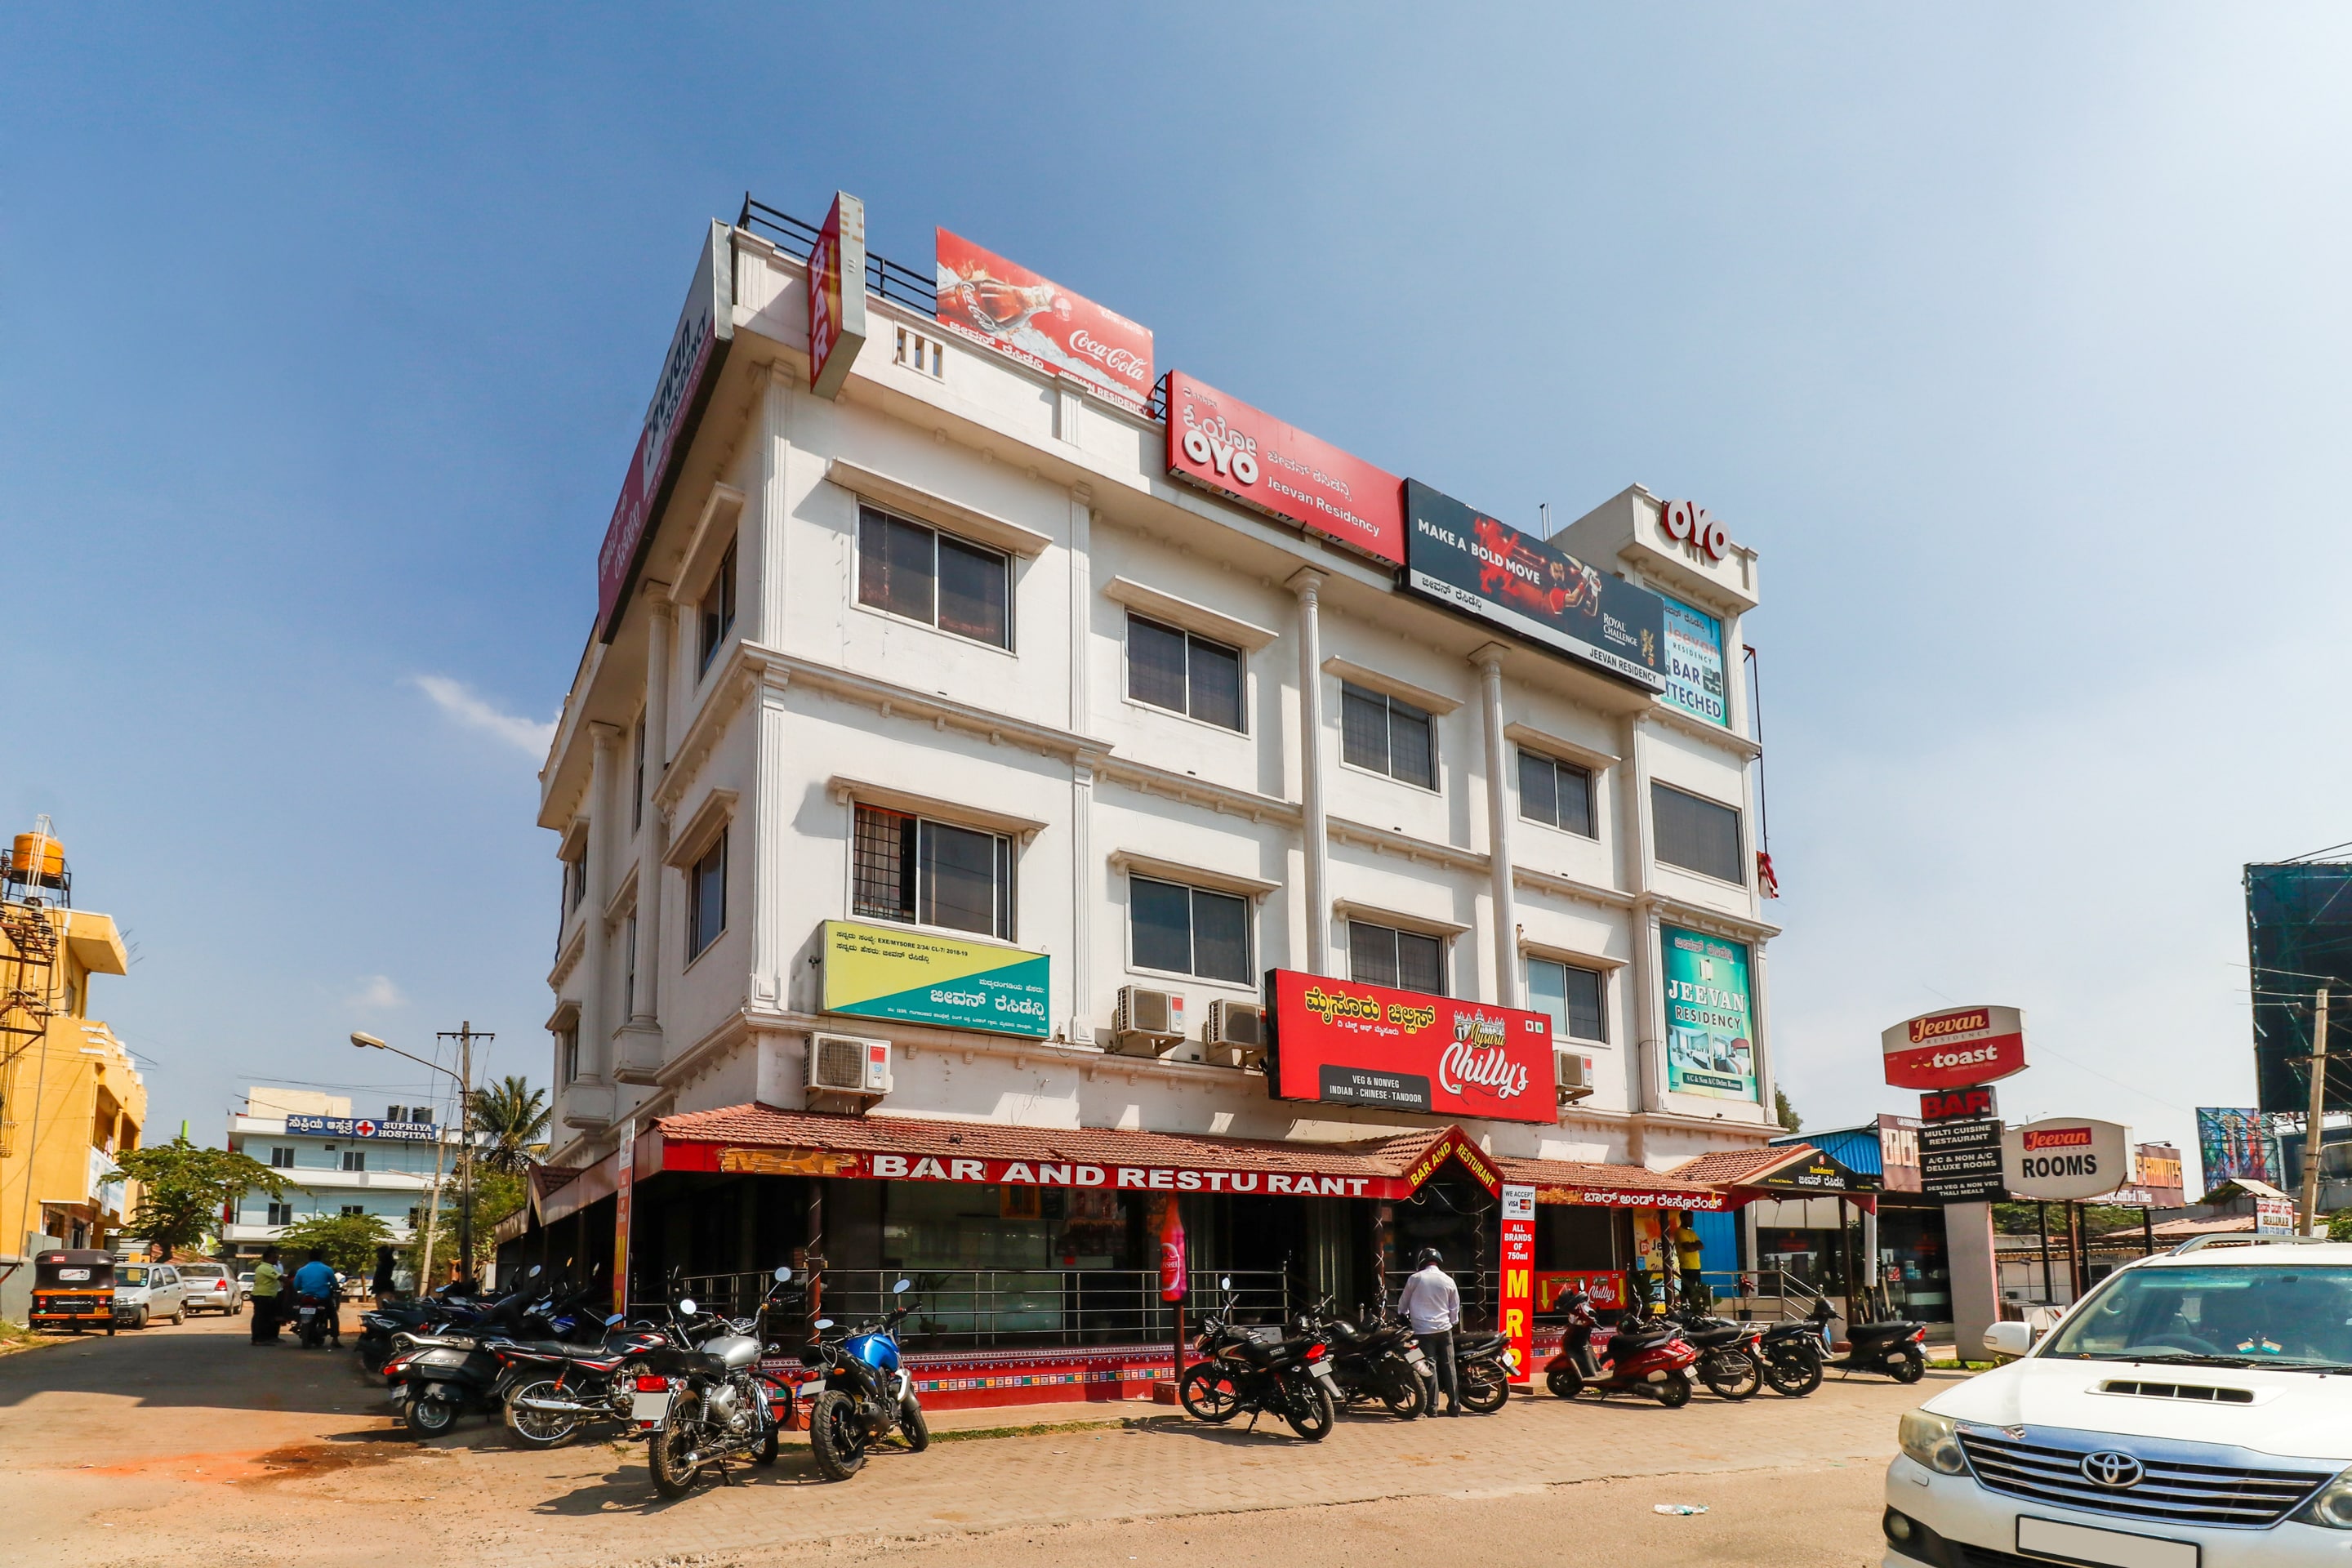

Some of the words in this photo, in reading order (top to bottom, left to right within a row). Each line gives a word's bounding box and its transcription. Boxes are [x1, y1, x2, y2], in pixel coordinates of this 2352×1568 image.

[812, 241, 828, 377] BAR
[1069, 329, 1147, 381] Coca-Cola
[1098, 387, 1147, 415] RESIDENCY
[1184, 430, 1259, 484] OYO
[1267, 476, 1314, 506] Jeevan
[1316, 497, 1380, 537] Residency
[1666, 497, 1731, 560] OYO
[1418, 518, 1455, 546] MAKE
[1457, 536, 1468, 552] A
[1471, 541, 1503, 568] BOLD
[1506, 557, 1540, 585] MOVE
[1603, 612, 1627, 633] ROYAL
[1603, 624, 1638, 647] CHALLENGE
[1668, 621, 1720, 658] Jeevan
[1589, 648, 1619, 669] JEEVAN
[1619, 656, 1657, 684] RESIDENCY
[1673, 642, 1713, 666] RESIDENCY
[1673, 657, 1700, 686] BAR
[1665, 680, 1722, 719] TTECHED
[947, 948, 969, 956] 2018-19
[930, 989, 986, 1008] ಜೀವನ್
[1305, 987, 1381, 1024] ಮೈಸೂರು
[1668, 979, 1745, 1013] JEEVAN
[1675, 1004, 1741, 1031] RESIDENCY
[1912, 1014, 1986, 1042] Jeevan
[1927, 1030, 1990, 1045] RESIDENCY
[1932, 1045, 1998, 1068] toast
[1352, 1075, 1365, 1085] VEG
[1366, 1076, 1372, 1085] &
[1374, 1077, 1400, 1089] NONVEG
[1438, 1041, 1530, 1099] Chilly's
[1330, 1085, 1353, 1096] INDIAN
[1359, 1089, 1388, 1099] CHINESE
[1392, 1092, 1423, 1103] TANDOOR
[1922, 1091, 1990, 1120] BAR
[377, 1129, 434, 1140] HOSPITAL
[382, 1121, 433, 1132] SUPRIYA
[1924, 1129, 1951, 1138] MULTI
[1953, 1125, 1992, 1134] CUISINE
[1929, 1134, 1989, 1146] RESTAURANT
[2026, 1131, 2090, 1152] Jeevan
[873, 1154, 987, 1182] BAR
[1000, 1160, 1106, 1187] AND
[1410, 1161, 1432, 1187] BAR
[1432, 1142, 1451, 1167] AND
[1456, 1143, 1496, 1187] RESTURANT
[1927, 1163, 1961, 1173] DELUXE
[1963, 1160, 1998, 1169] ROOMS
[1928, 1156, 1944, 1165] A/C
[1954, 1154, 1976, 1162] NON
[2022, 1154, 2097, 1178] ROOMS
[1584, 1192, 1618, 1203] ಬಾರ್
[1504, 1233, 1532, 1242] BRANDS
[1512, 1224, 1525, 1232] ALL
[1508, 1252, 1529, 1260] 750ml
[1513, 1243, 1523, 1251] OF
